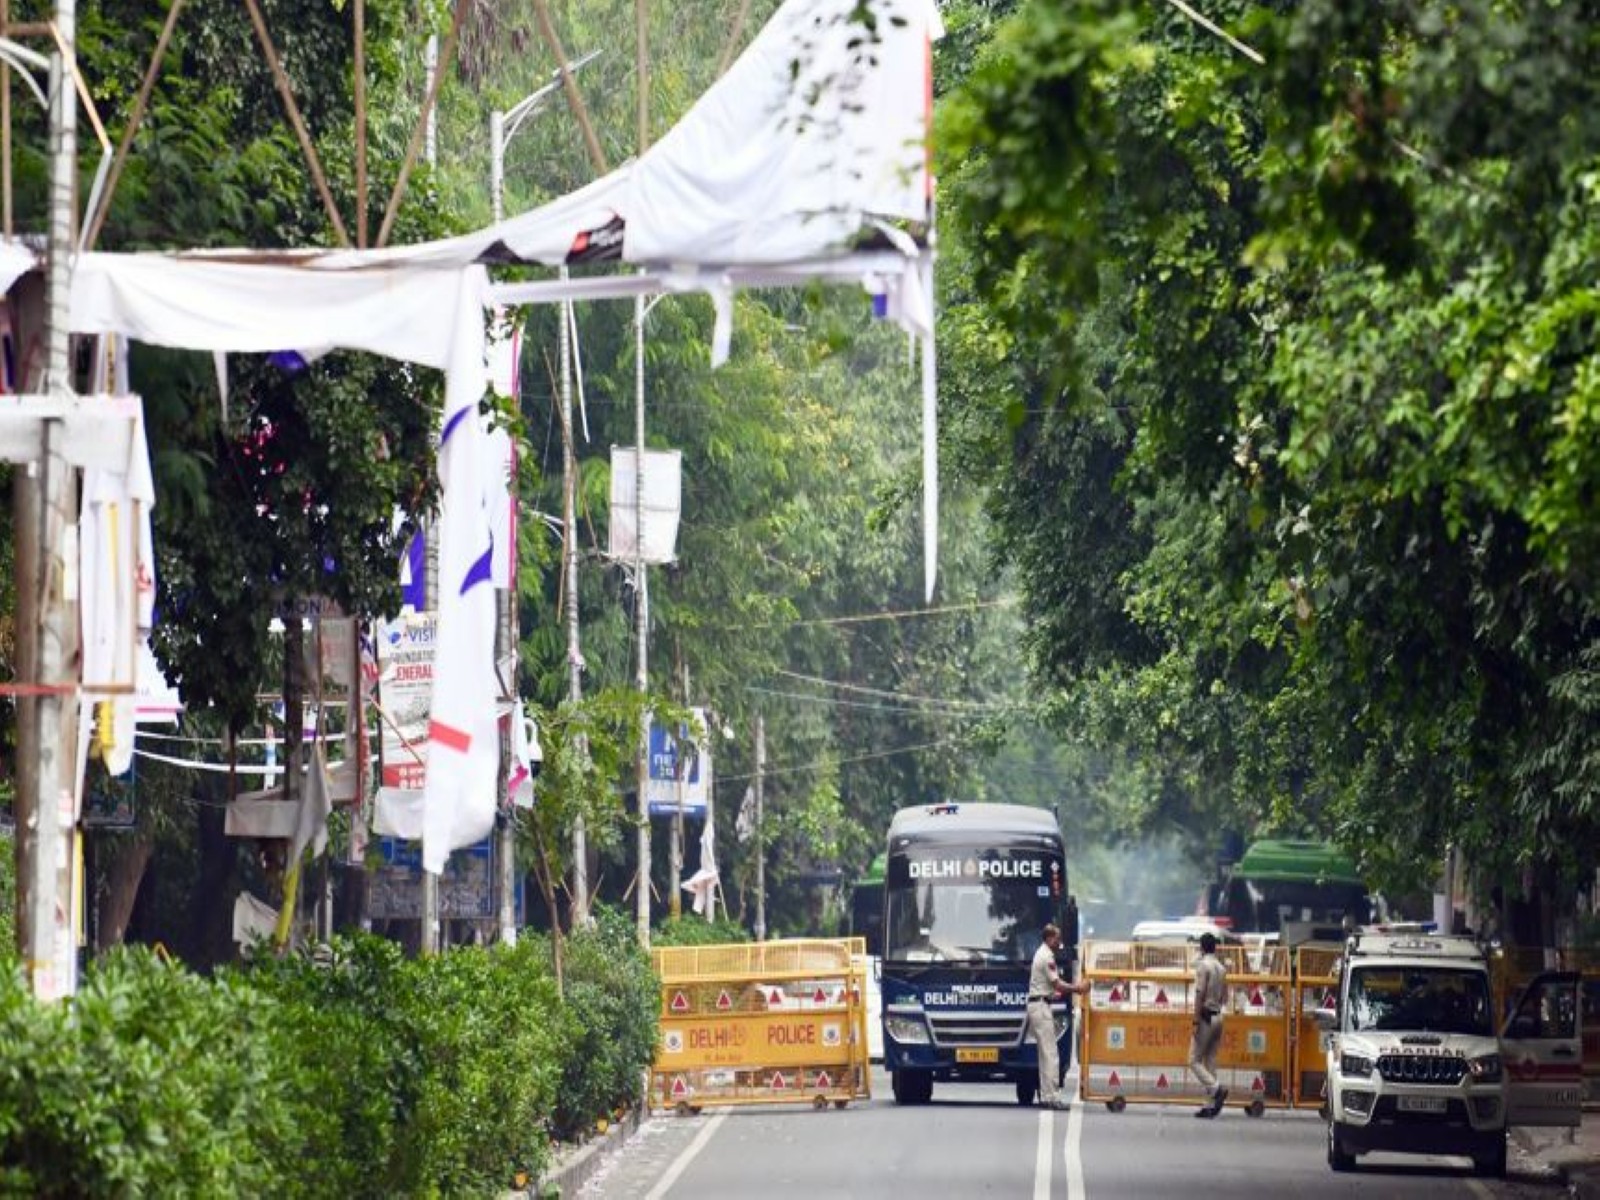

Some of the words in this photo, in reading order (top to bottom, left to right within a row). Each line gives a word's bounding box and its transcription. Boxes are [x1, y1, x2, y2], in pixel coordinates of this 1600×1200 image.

[396, 664, 433, 680] ENERAL
[909, 861, 961, 878] DELHI
[978, 860, 1042, 878] POLICE
[924, 992, 958, 1005] DELHI
[689, 1027, 728, 1049] DELHI
[766, 1023, 816, 1047] POLICE
